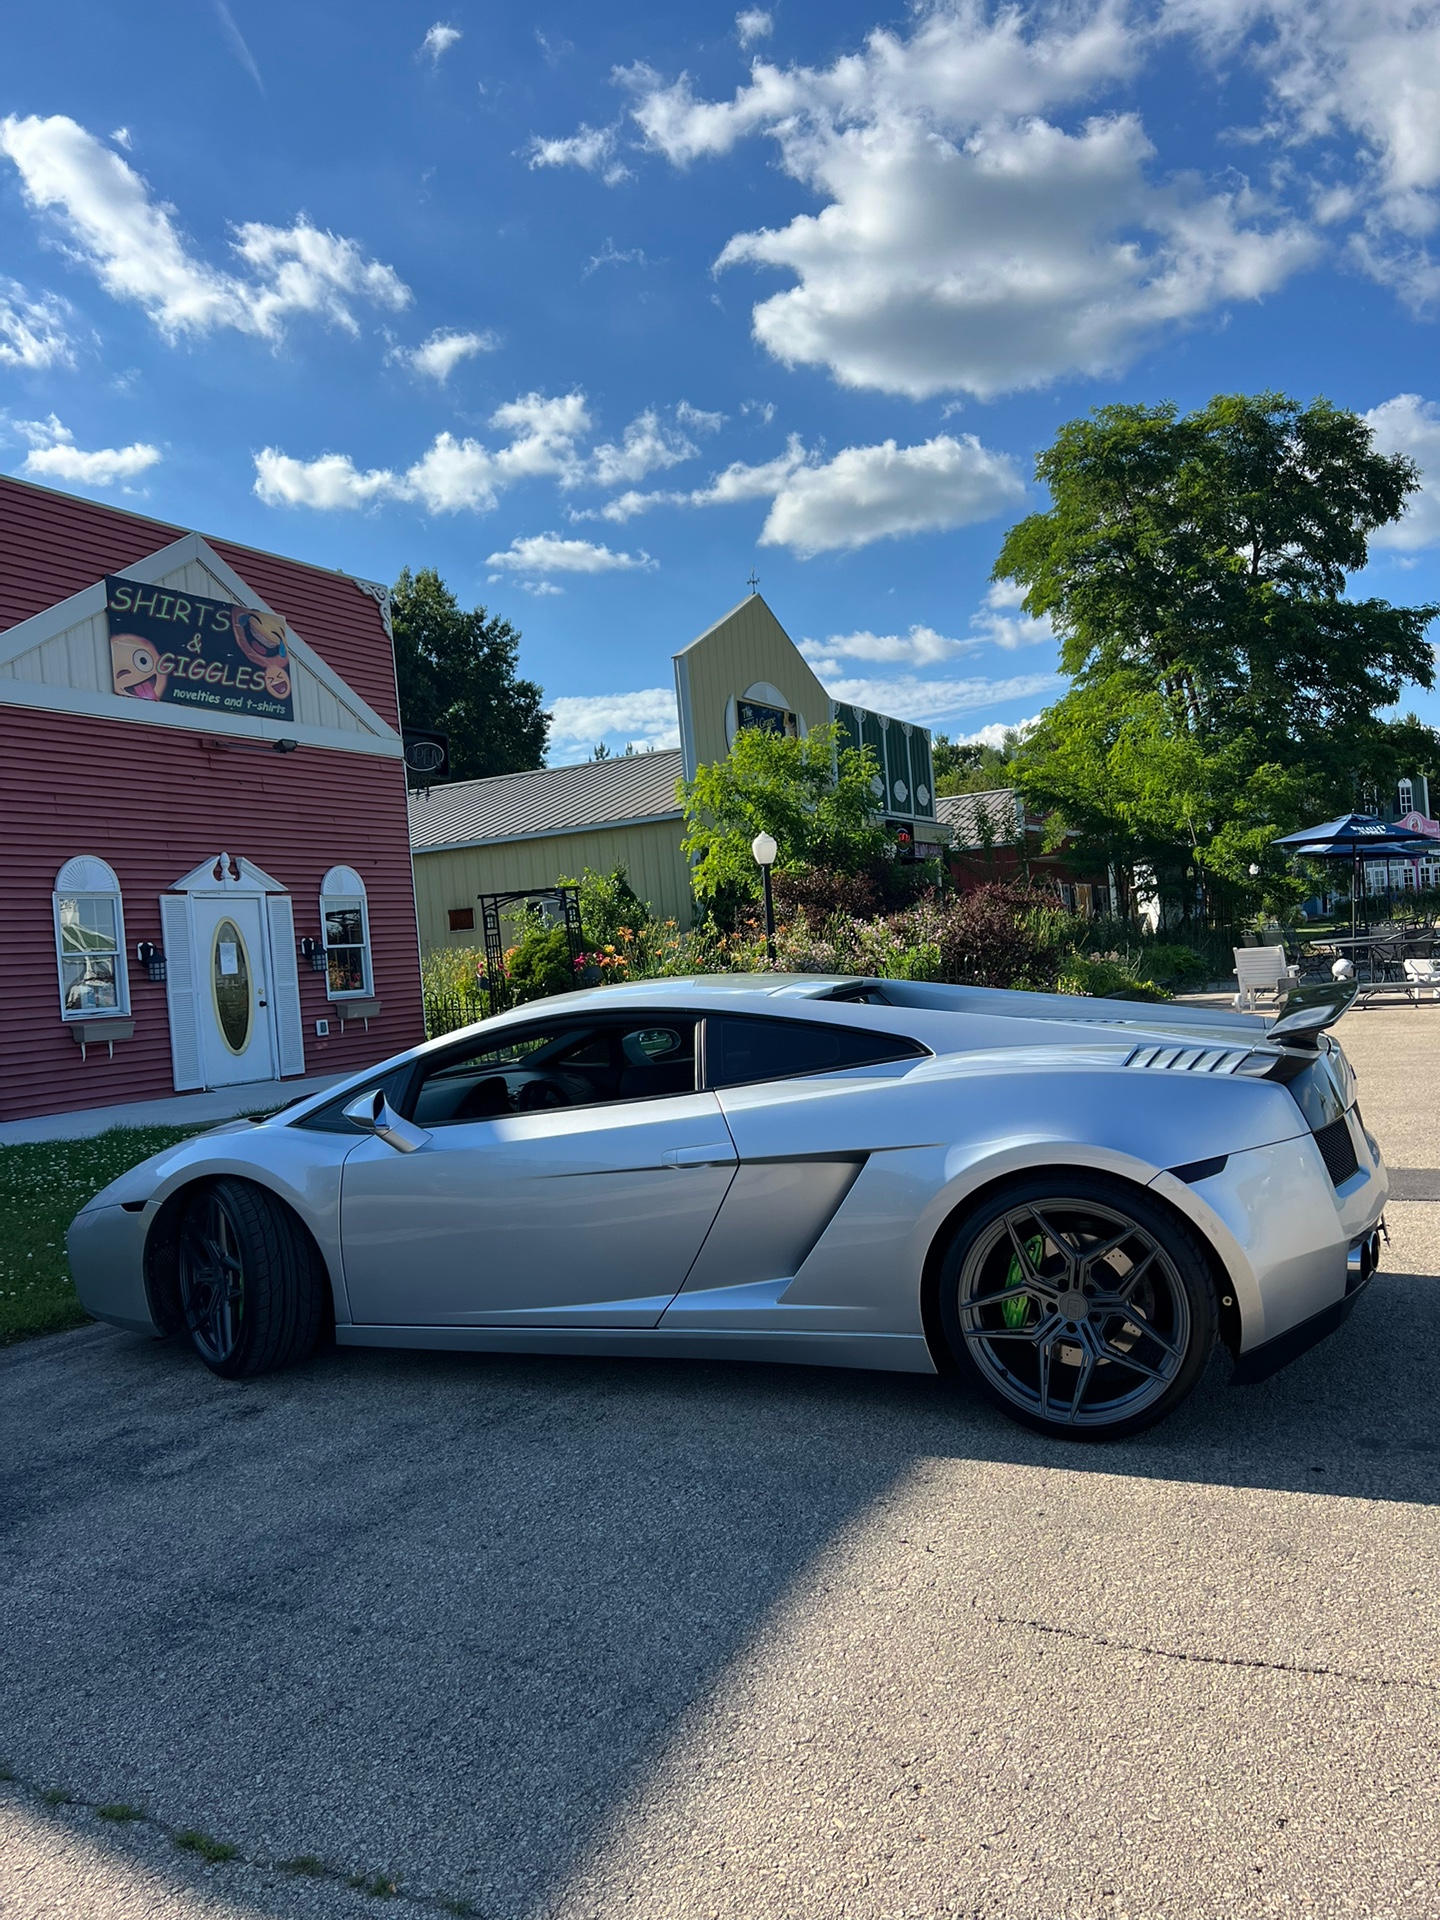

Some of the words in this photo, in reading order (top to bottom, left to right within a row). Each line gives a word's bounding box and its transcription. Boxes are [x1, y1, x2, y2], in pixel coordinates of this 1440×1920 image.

[110, 586, 231, 631] SHIRTS
[186, 632, 202, 654] &
[157, 652, 266, 690] GIGGLES
[173, 689, 221, 704] novelties
[223, 696, 244, 708] and
[246, 700, 287, 715] t-shirts
[405, 745, 441, 767] OPEN
